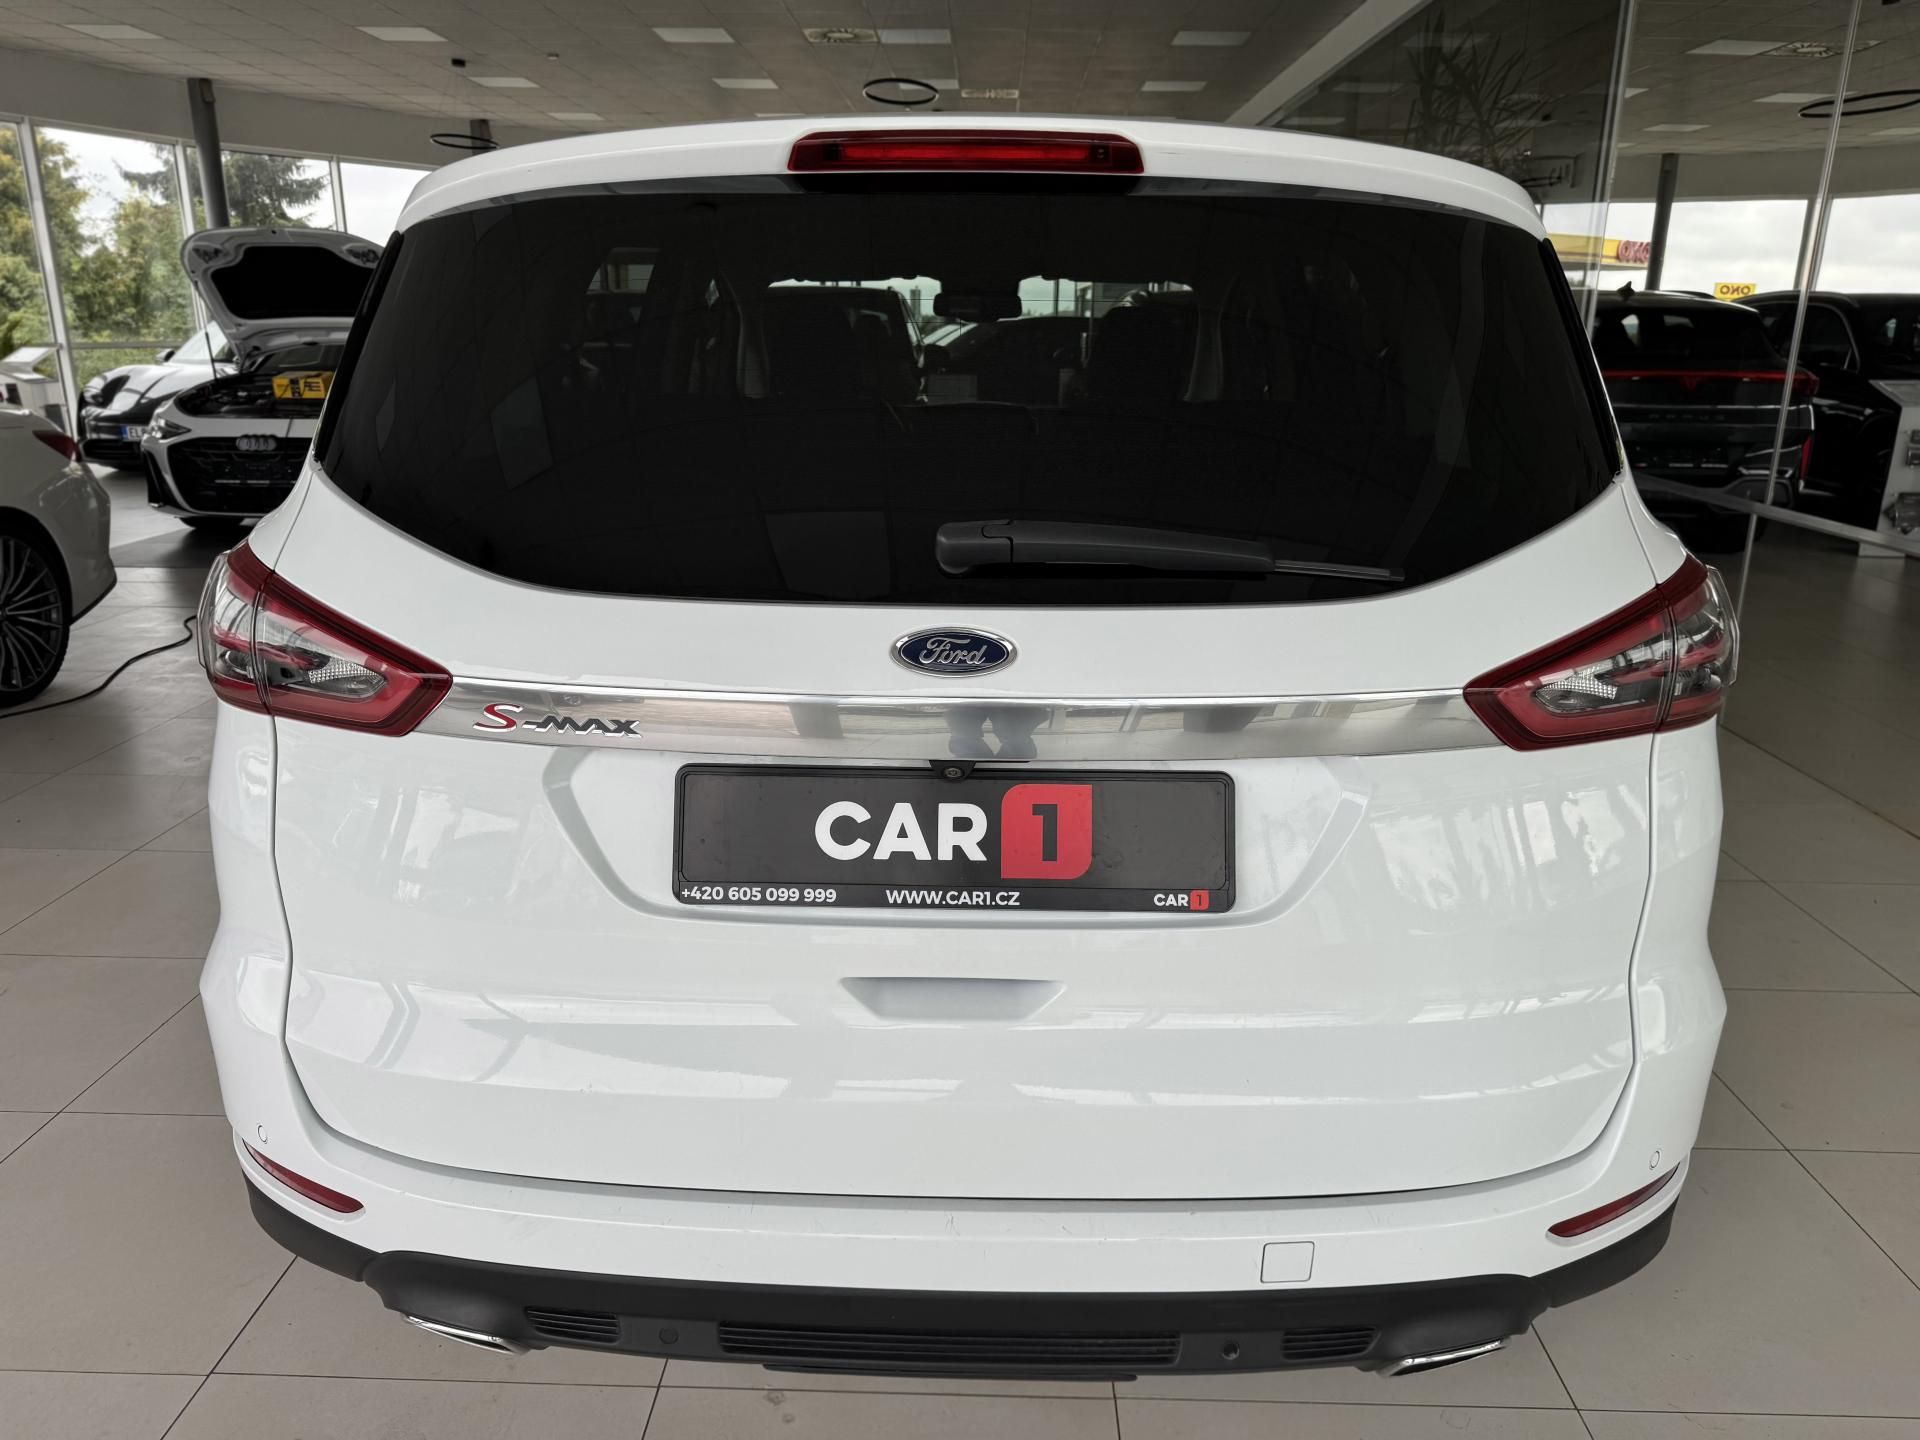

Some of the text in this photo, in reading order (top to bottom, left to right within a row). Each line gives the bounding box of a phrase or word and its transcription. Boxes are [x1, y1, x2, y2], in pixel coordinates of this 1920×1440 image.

[919, 637, 987, 665] Ford
[473, 703, 642, 738] S-MAX
[815, 801, 1058, 862] CAR 1
[681, 886, 837, 903] +420 605 099 999
[885, 889, 1021, 906] WWW.CAR1.CZ
[1153, 893, 1189, 907] CAR
